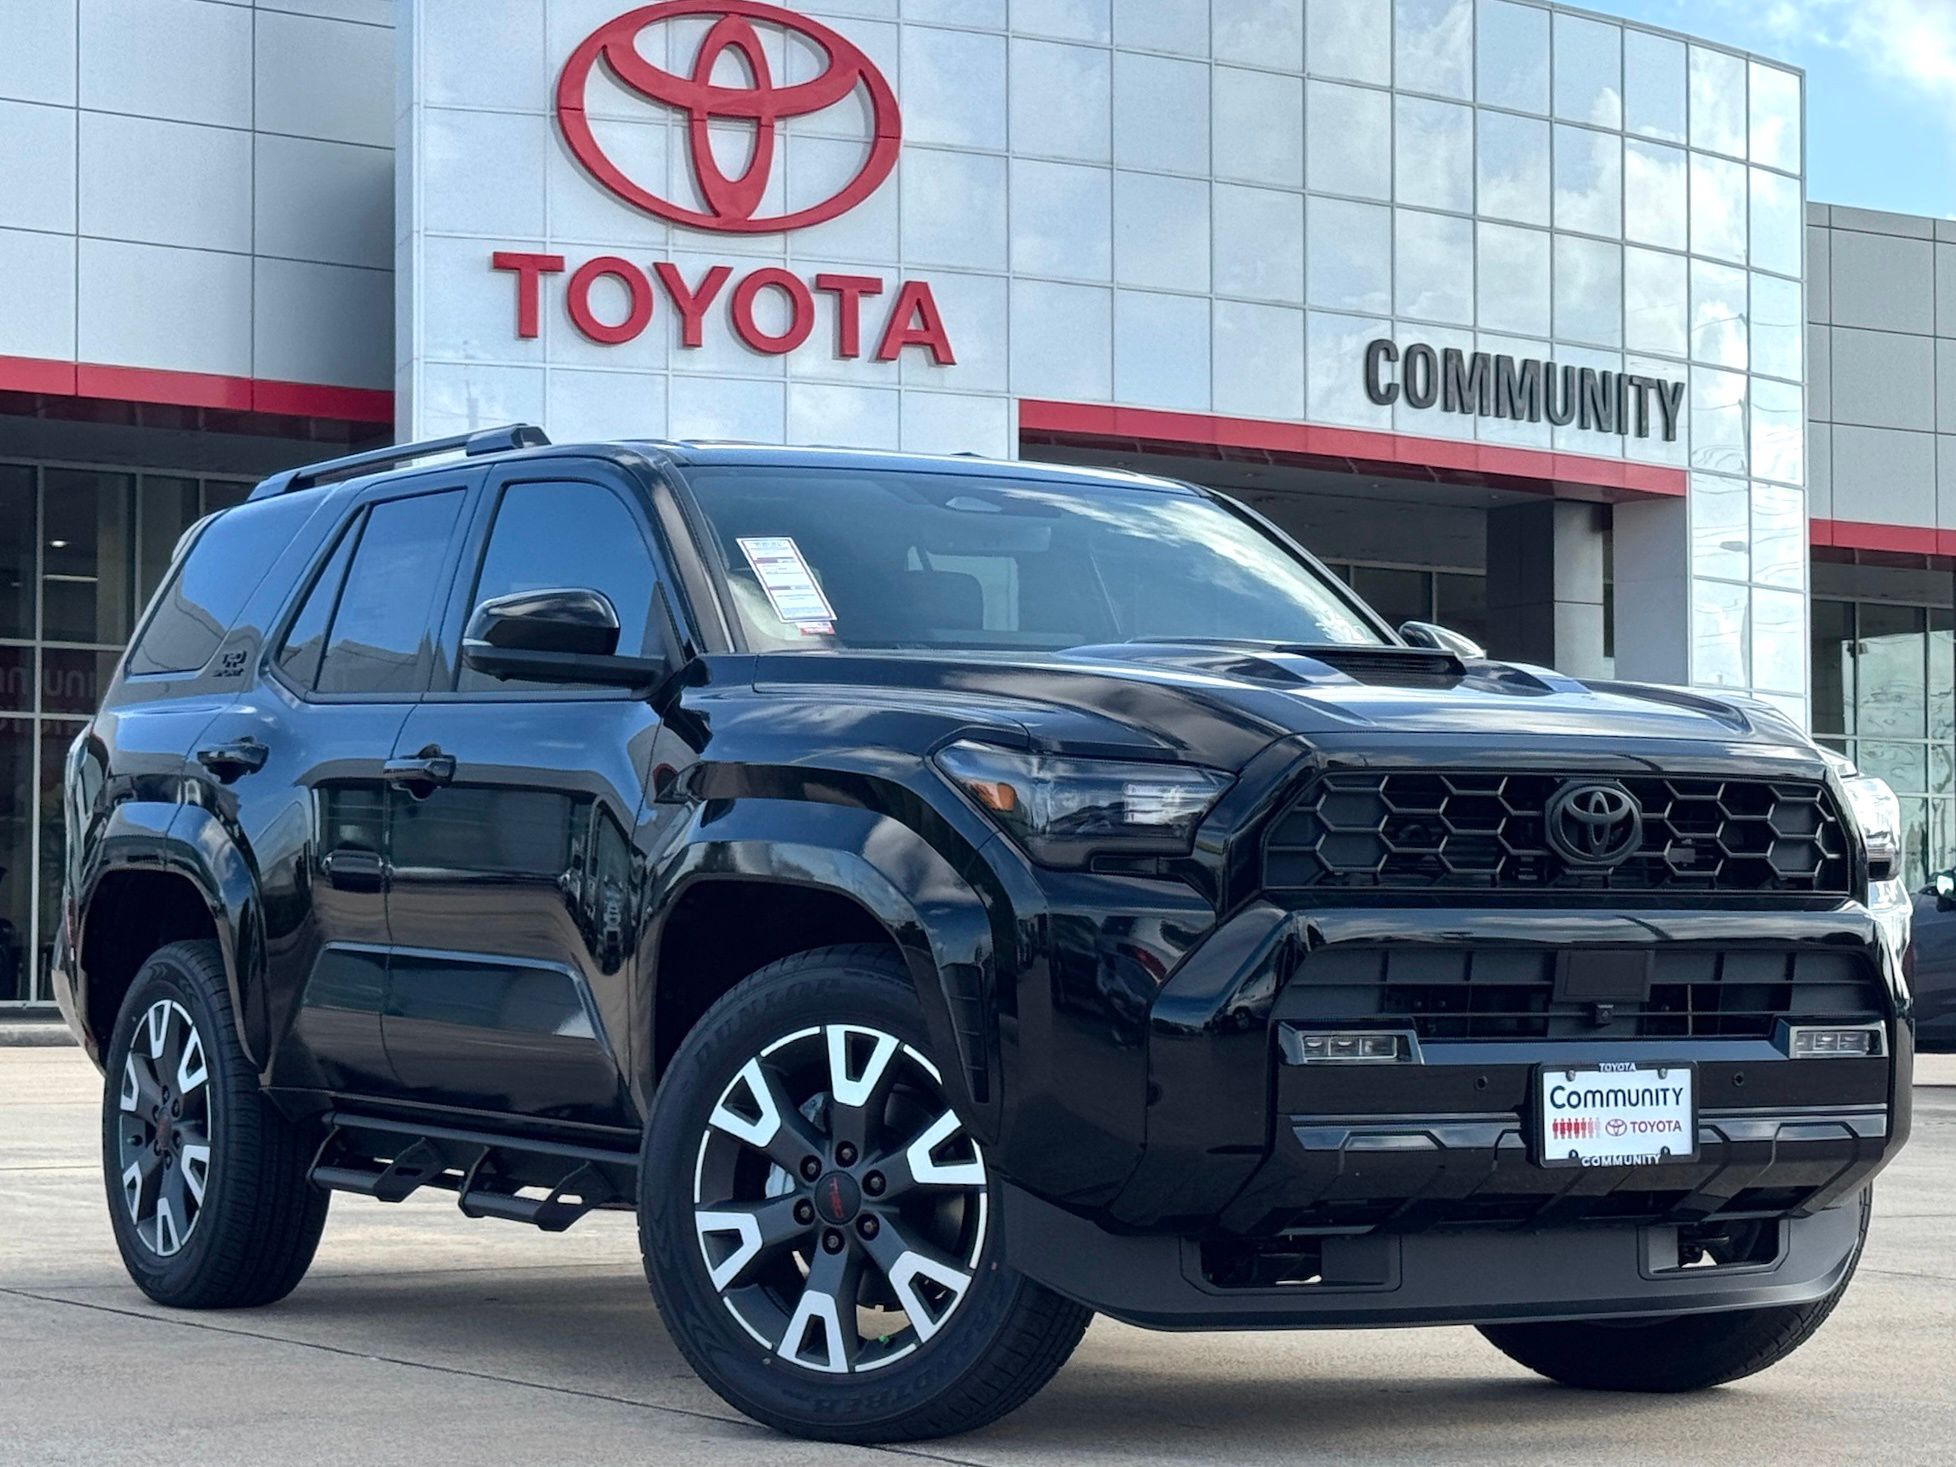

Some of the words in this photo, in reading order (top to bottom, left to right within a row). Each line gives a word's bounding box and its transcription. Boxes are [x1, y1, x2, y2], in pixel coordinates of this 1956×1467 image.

[492, 251, 957, 366] TOYOTA
[1365, 338, 1686, 442] COMMUNITY
[1599, 1062, 1637, 1073] TOYOTA
[1630, 1120, 1682, 1134] TOYOTA
[1581, 1154, 1661, 1167] COMMUNITY
